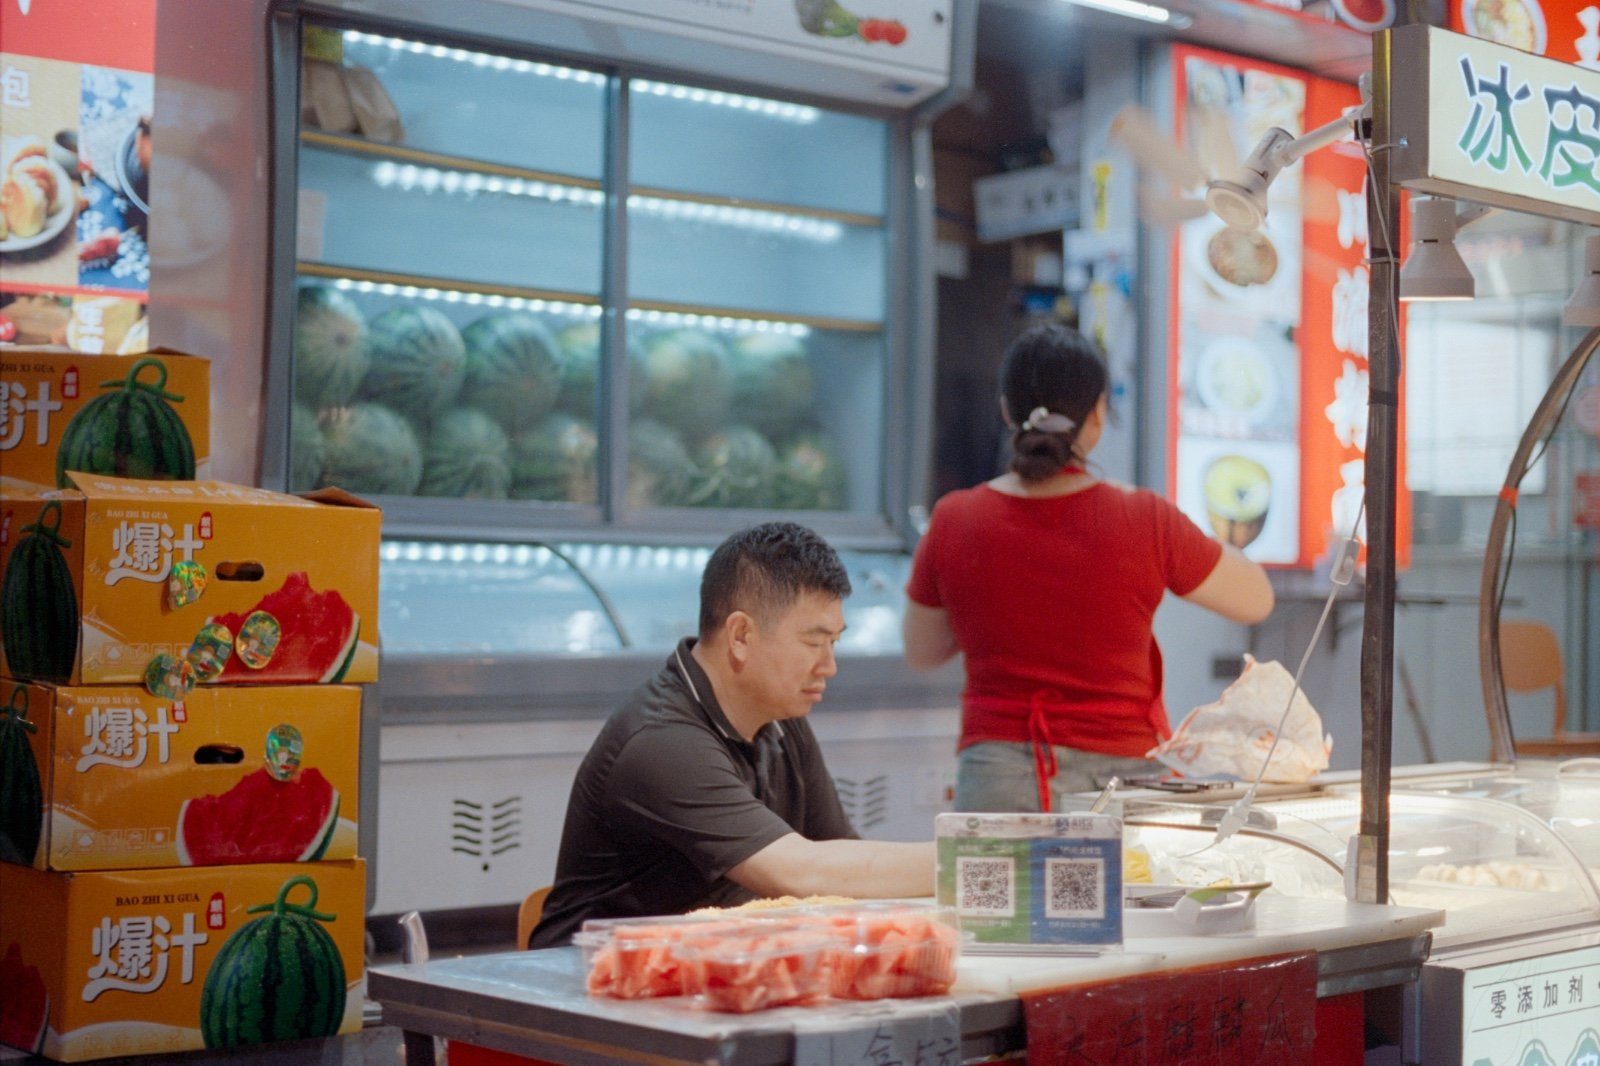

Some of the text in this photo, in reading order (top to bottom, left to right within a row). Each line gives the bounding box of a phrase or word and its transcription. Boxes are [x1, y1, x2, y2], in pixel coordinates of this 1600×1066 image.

[1457, 54, 1600, 196] 冰皮
[106, 509, 124, 518] BAO
[125, 510, 140, 519] ZHI
[151, 511, 168, 520] GUA
[104, 520, 205, 587] 爆汁
[77, 696, 94, 704] BAO
[95, 696, 110, 704] ZHI
[122, 697, 140, 705] GUA
[76, 706, 179, 773] 爆汁
[115, 893, 200, 907] BAO ZHI XI GUA
[82, 912, 208, 1003] 爆汁
[1490, 974, 1583, 1019] 零添加剂
